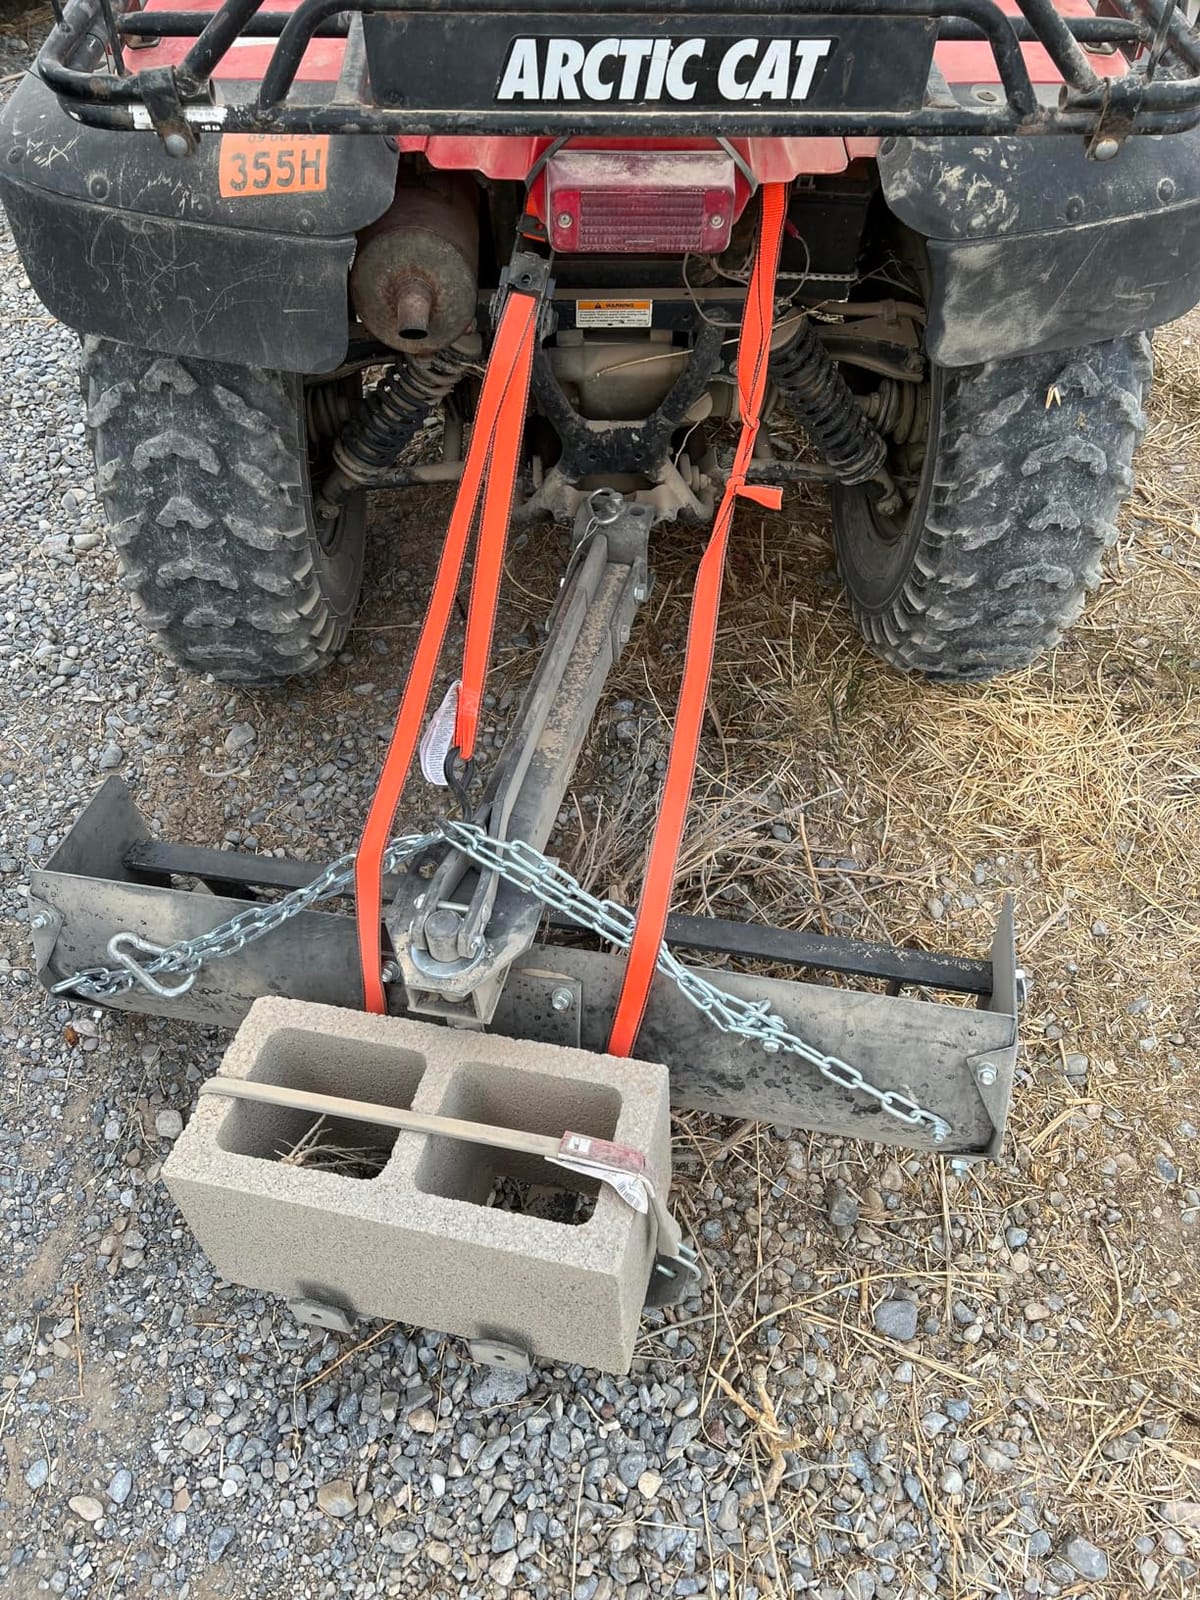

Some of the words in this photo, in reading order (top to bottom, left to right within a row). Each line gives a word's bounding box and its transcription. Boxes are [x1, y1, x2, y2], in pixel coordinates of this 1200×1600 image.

[497, 38, 706, 100] ARCTIC
[718, 38, 832, 100] CAT
[230, 149, 321, 191] 355H
